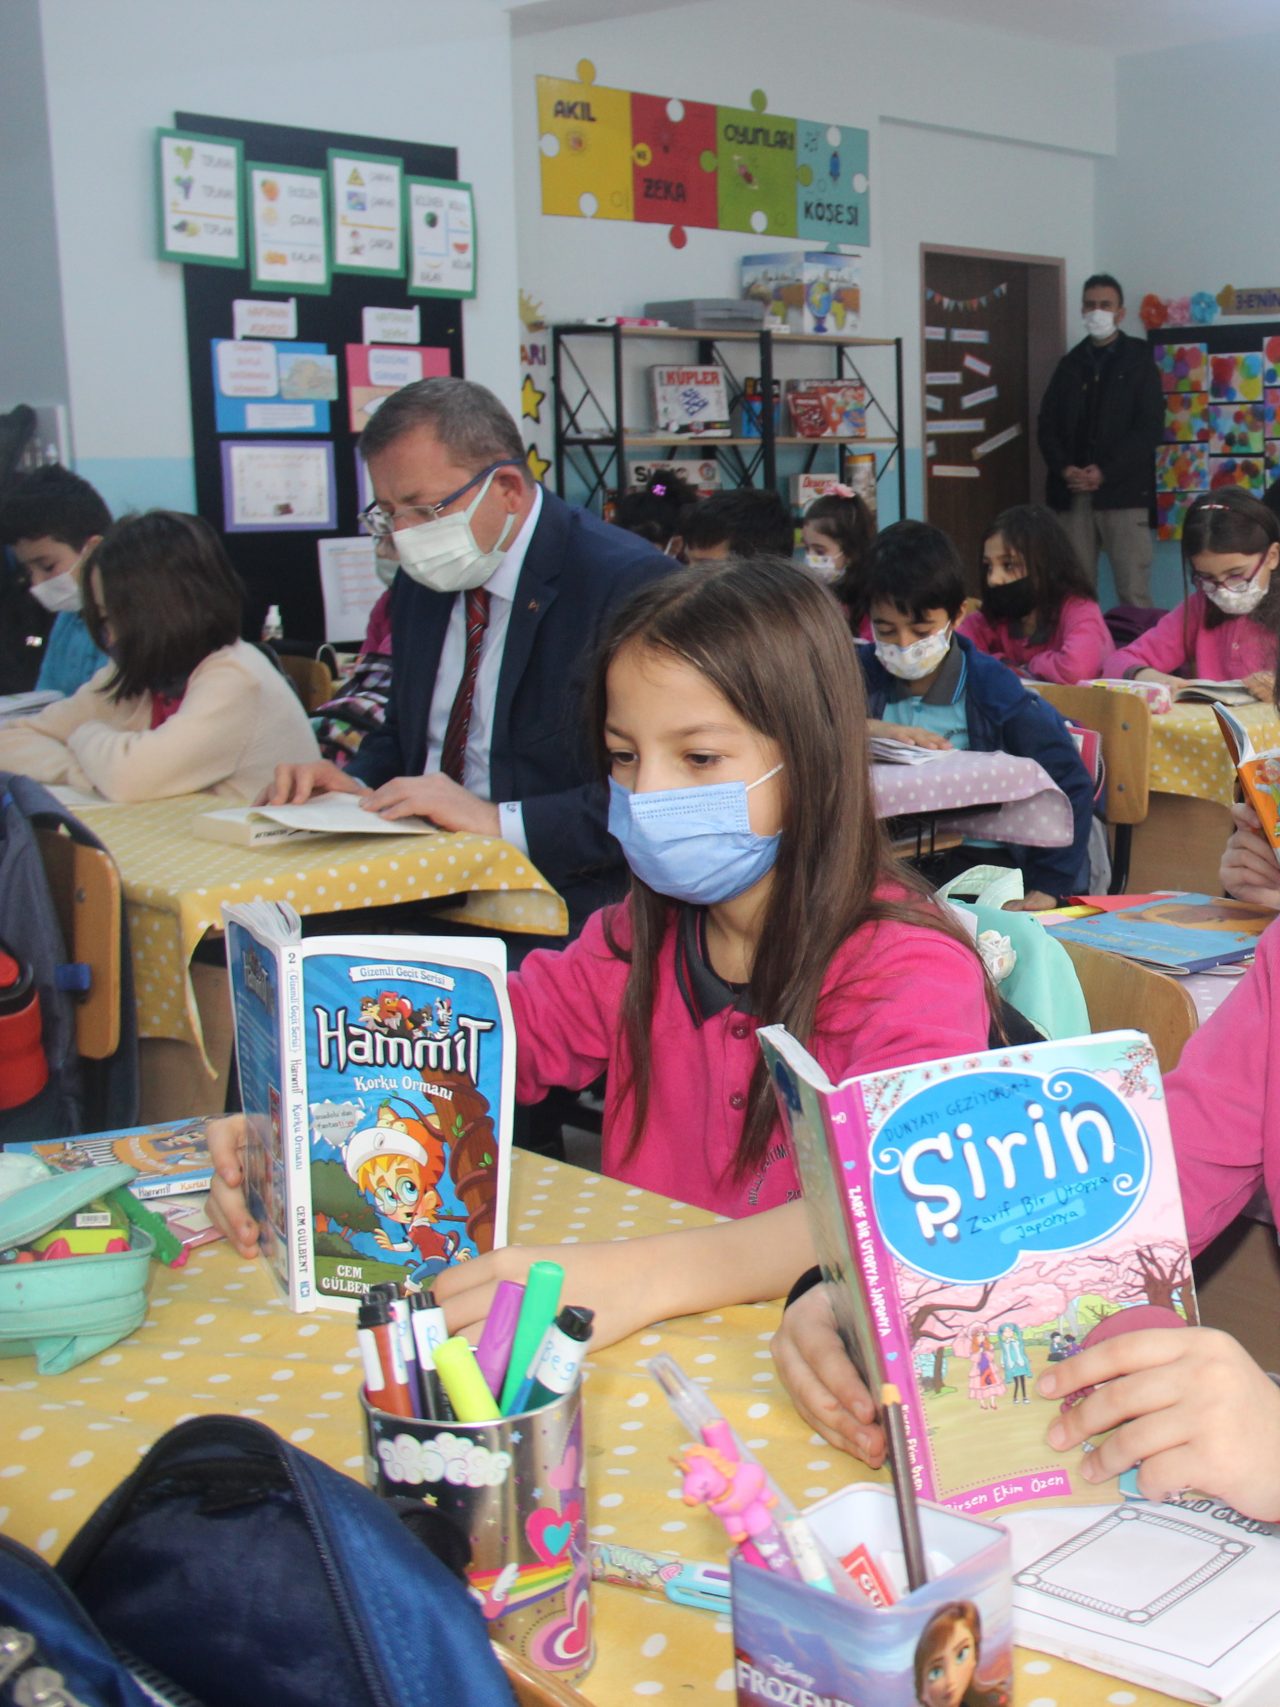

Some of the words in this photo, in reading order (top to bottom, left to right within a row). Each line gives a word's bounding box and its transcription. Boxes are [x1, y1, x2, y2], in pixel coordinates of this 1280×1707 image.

[553, 100, 597, 122] AKIL
[642, 177, 687, 203] ZEKA
[722, 123, 796, 151] OYUNLARI
[666, 368, 721, 386] KÜPLER
[288, 952, 296, 964] 2
[353, 1075, 399, 1092] Korku
[401, 1076, 454, 1101] Ormanı
[900, 1101, 1116, 1240] Şirin
[296, 1205, 306, 1227] CEM
[965, 1200, 1011, 1235] Zarif
[1020, 1195, 1046, 1216] Bir
[1015, 1208, 1080, 1239] Japonya
[321, 1275, 374, 1295] GÜLBEN
[337, 1264, 363, 1280] CEM
[992, 1484, 1024, 1503] Ekim
[1030, 1474, 1064, 1493] Özen
